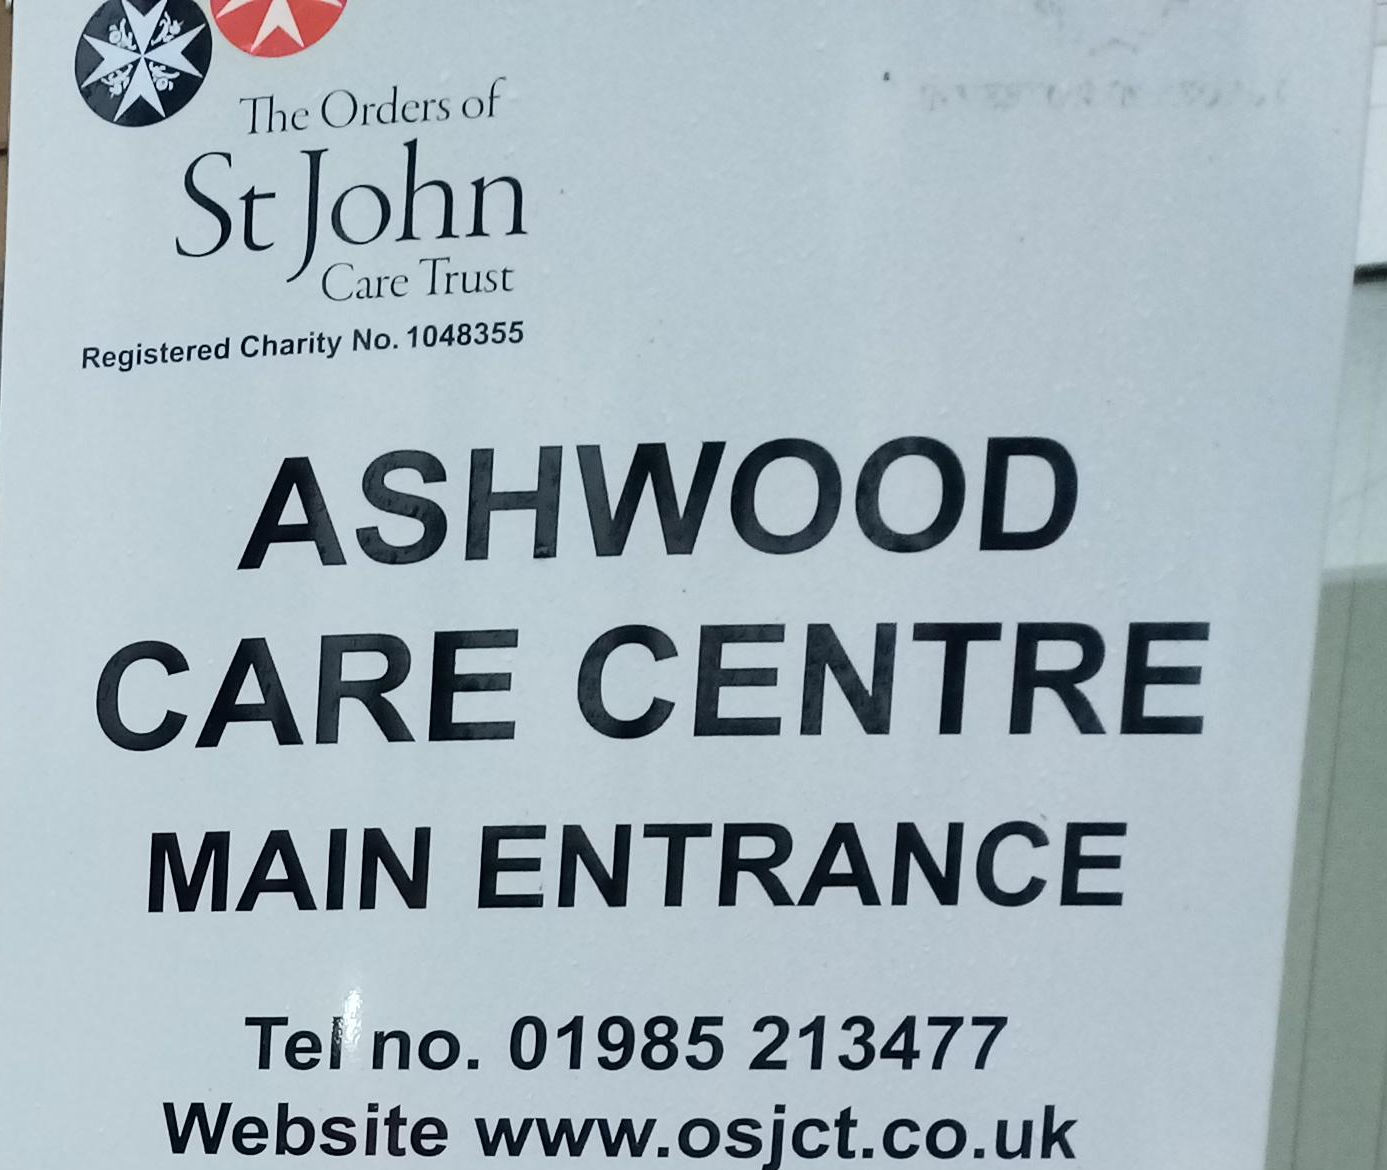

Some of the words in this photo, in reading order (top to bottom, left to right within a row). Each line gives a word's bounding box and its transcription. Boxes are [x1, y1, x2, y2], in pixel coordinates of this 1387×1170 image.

[240, 95, 309, 135] The
[321, 86, 451, 128] Orders
[462, 76, 507, 118] of
[175, 150, 276, 257] St
[286, 137, 528, 283] John
[322, 261, 409, 302] Care
[419, 256, 515, 297] Trust
[81, 337, 230, 372] Registered
[240, 330, 342, 362] Charity
[352, 328, 399, 352] No.
[407, 320, 525, 349] 1048355
[237, 434, 1080, 570] ASHWOOD
[94, 628, 520, 752] CARE
[576, 620, 1211, 740] CENTRE
[147, 825, 431, 914] MAIN
[476, 820, 1129, 910] ENTRANCE
[243, 1014, 344, 1072] Tel
[370, 1027, 482, 1072] no.
[508, 1014, 726, 1072] 01985
[748, 1015, 1010, 1072] 213477
[162, 1102, 449, 1158] Website
